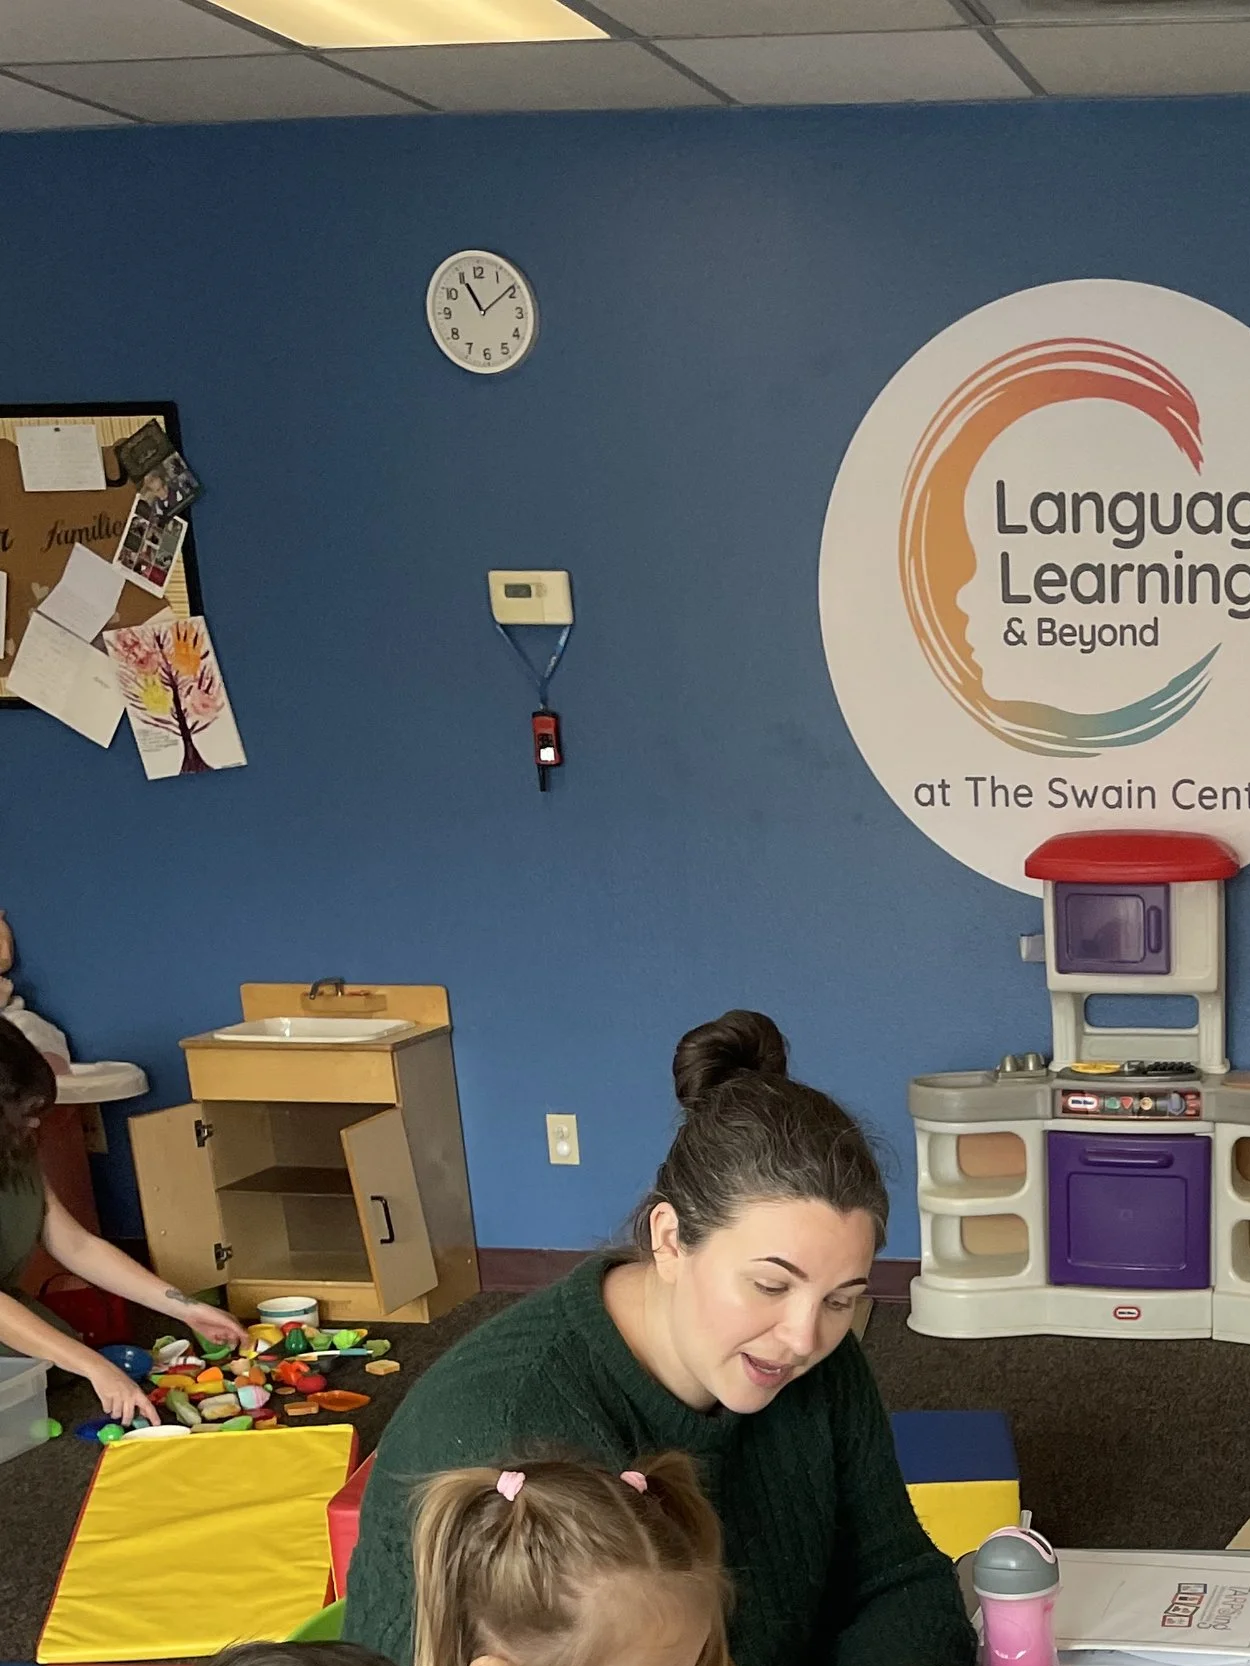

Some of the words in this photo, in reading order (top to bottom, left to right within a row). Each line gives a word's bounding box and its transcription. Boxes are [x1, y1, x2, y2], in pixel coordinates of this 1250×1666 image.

[473, 266, 485, 279] 12
[446, 287, 459, 301] 10
[508, 284, 516, 299] 2
[443, 307, 452, 319] 9
[515, 307, 524, 319] 3
[451, 327, 460, 340] 8
[512, 327, 520, 340] 4
[465, 342, 474, 355] 7
[483, 348, 492, 360] 6
[501, 342, 510, 355] 5
[40, 511, 127, 553] familie
[1003, 618, 1028, 647] &
[1037, 616, 1159, 654] Beyond
[914, 778, 951, 808] at
[965, 776, 1034, 808] The
[1047, 777, 1157, 811] Swain
